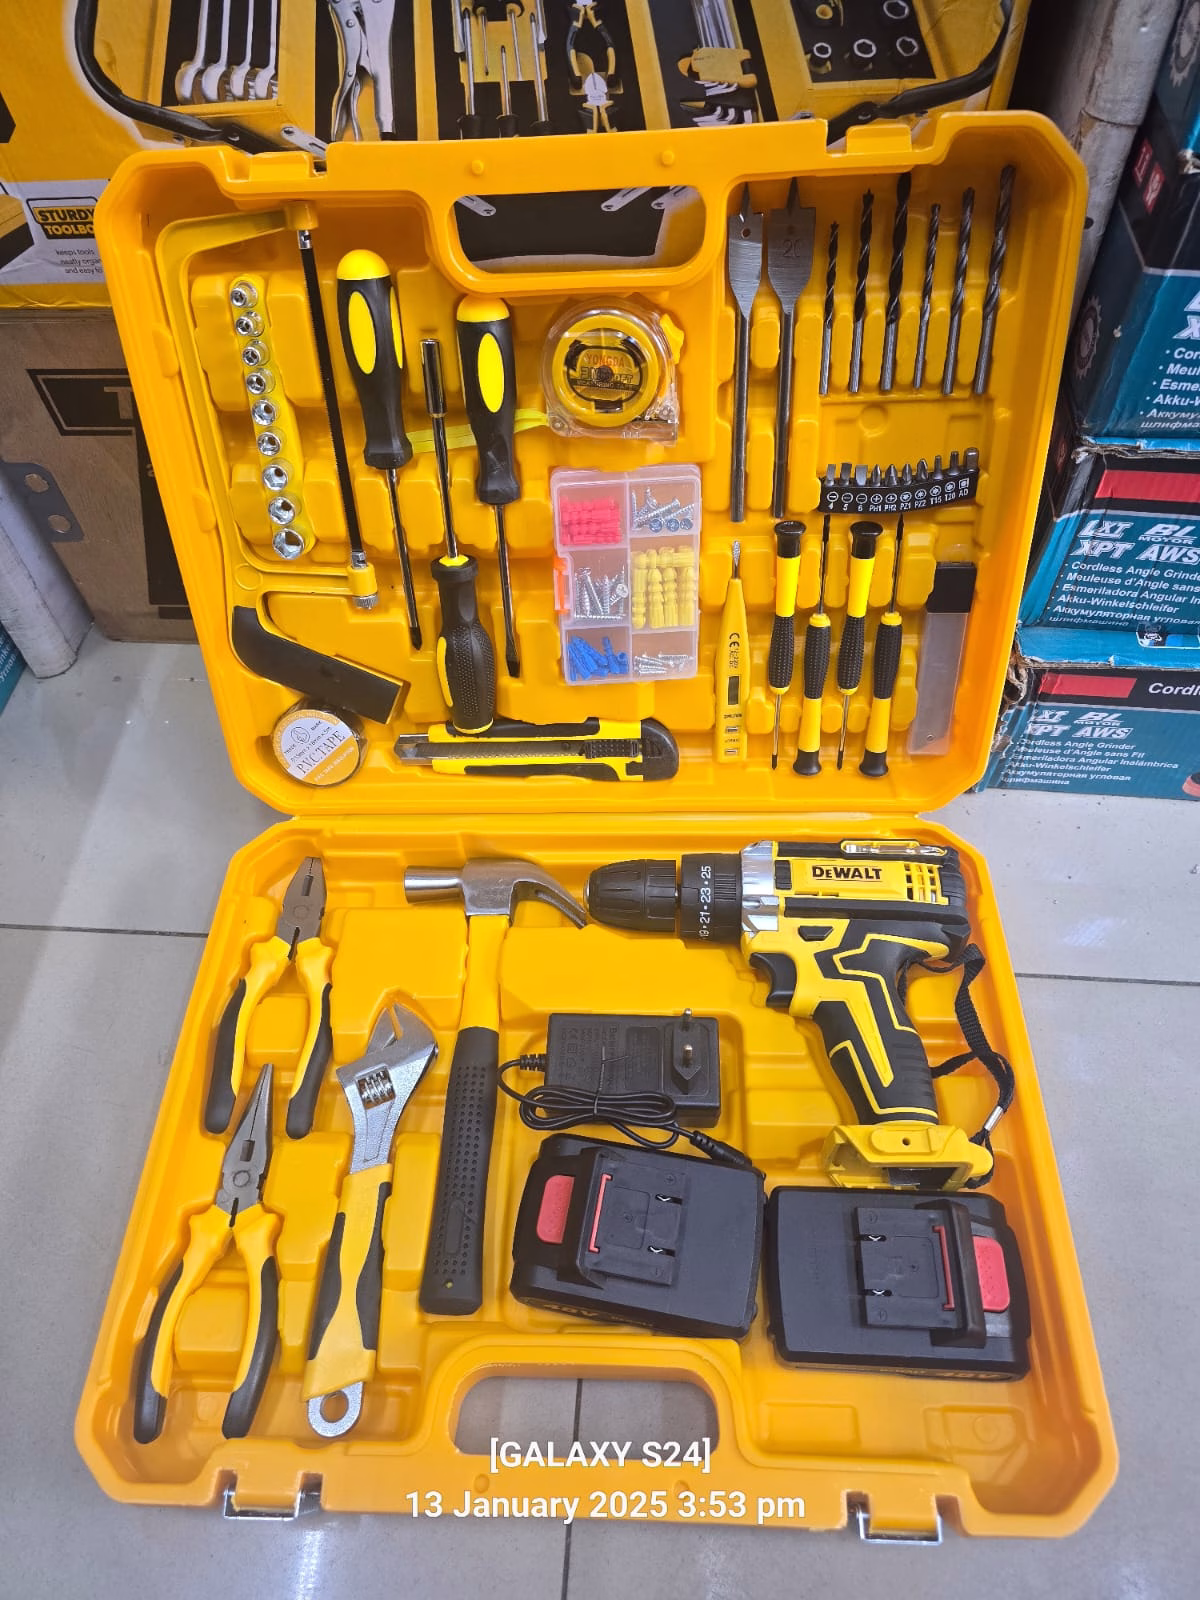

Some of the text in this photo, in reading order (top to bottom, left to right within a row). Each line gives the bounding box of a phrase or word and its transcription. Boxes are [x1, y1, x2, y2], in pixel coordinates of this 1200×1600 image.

[38, 208, 95, 221] STURDY
[1078, 520, 1197, 539] LXT BL
[1138, 535, 1195, 544] MOTOR
[1070, 540, 1200, 565] XPT AWS
[1071, 561, 1123, 573] Cordless
[1126, 566, 1160, 578] Angle
[1066, 572, 1200, 593] Meuleuse d'Angle sans
[1062, 583, 1138, 598] Esmeriladora
[1140, 590, 1187, 603] Angular
[1057, 594, 1180, 614] Akku-Winkelschleifer
[1053, 605, 1151, 621] Аккумуляторная
[1148, 682, 1200, 696] Cordl
[1072, 726, 1133, 739] AWS
[701, 865, 712, 879] 25
[700, 888, 711, 903] 23
[700, 911, 710, 924] 21
